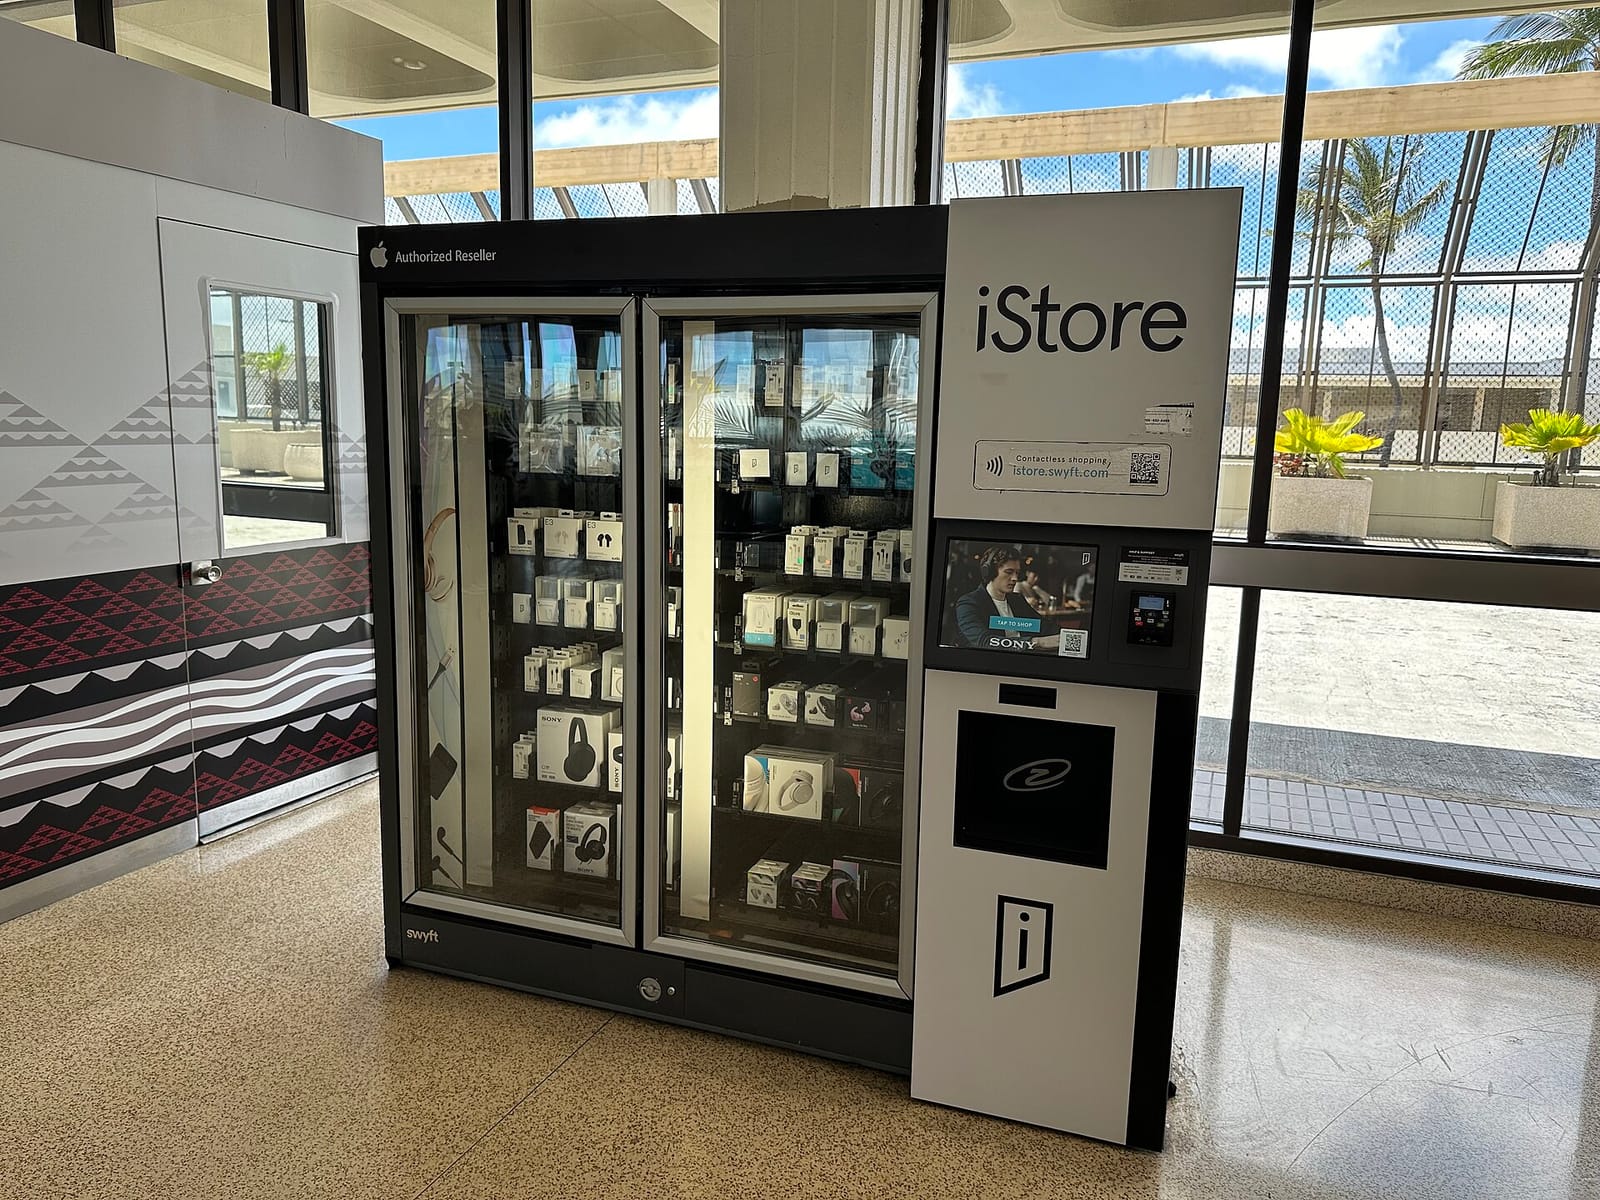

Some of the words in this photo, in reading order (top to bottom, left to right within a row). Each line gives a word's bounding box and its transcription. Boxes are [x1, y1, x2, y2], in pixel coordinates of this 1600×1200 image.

[395, 249, 452, 263] Authorized
[455, 249, 497, 262] Reseller
[976, 283, 1188, 353] iStore
[1016, 455, 1066, 463] Contactless
[1013, 466, 1109, 479] istore.swyft.com
[989, 637, 1038, 650] SONY
[406, 929, 439, 944] swyft
